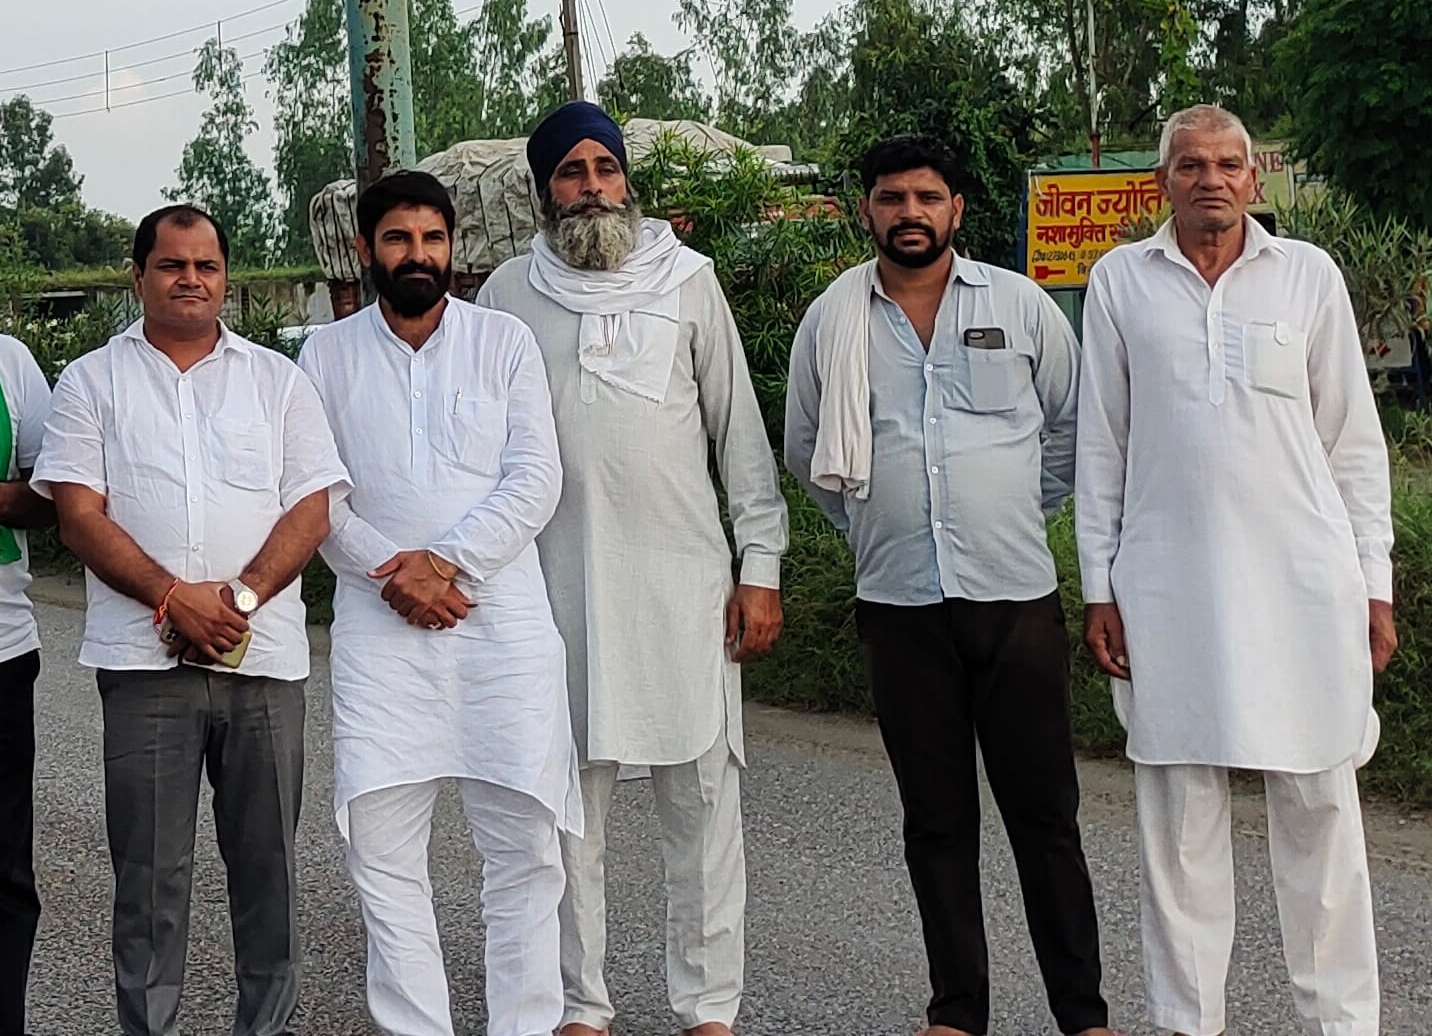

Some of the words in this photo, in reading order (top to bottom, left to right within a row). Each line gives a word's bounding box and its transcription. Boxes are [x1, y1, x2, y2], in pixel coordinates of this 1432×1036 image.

[1254, 151, 1284, 174] NE
[1034, 183, 1095, 218] जीवन
[1035, 216, 1108, 249] नशामुक्ति
